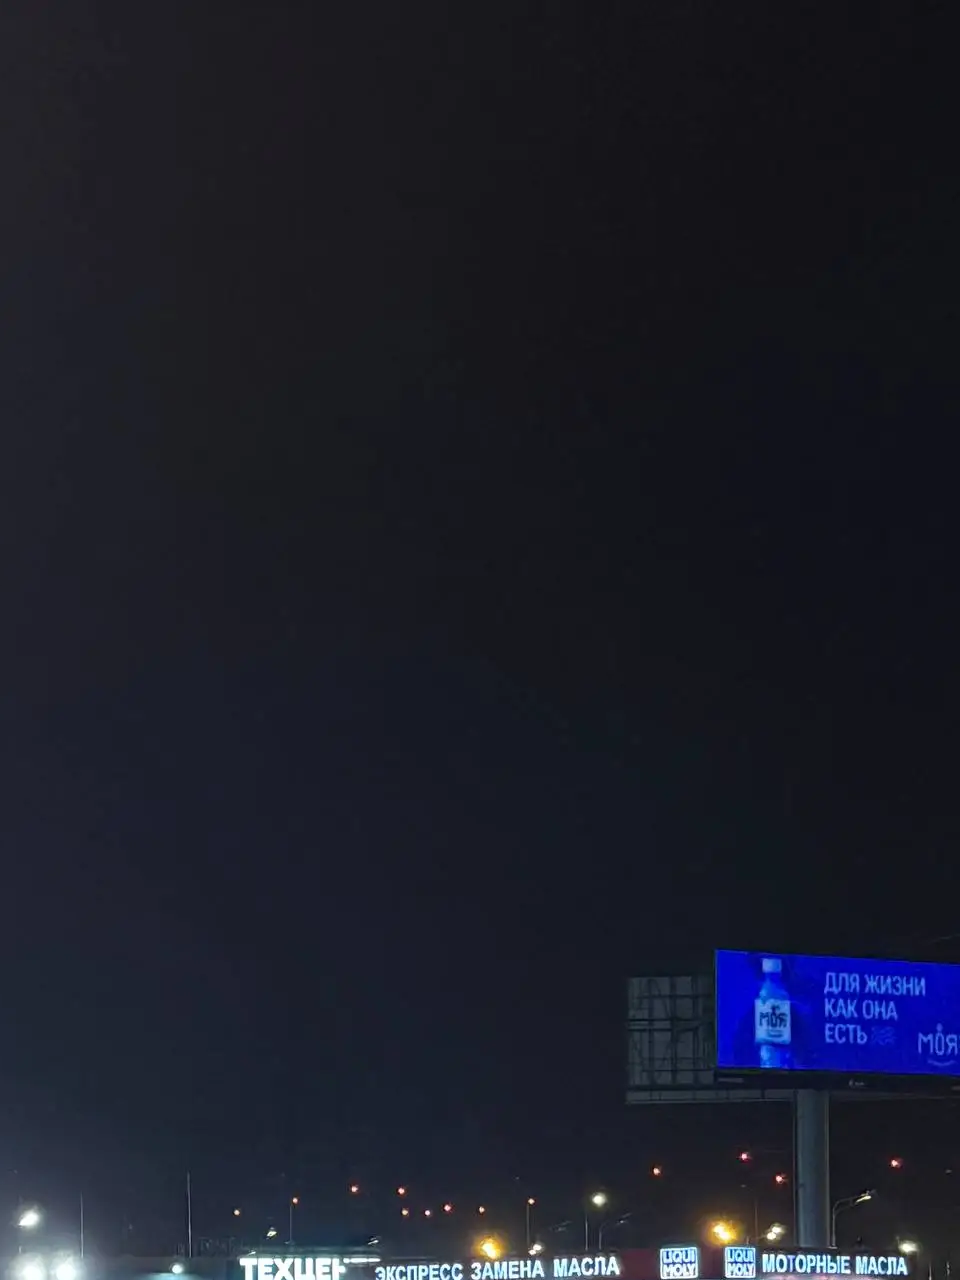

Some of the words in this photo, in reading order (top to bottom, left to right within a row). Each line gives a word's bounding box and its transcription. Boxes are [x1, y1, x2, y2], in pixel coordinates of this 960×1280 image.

[824, 972, 860, 994] ДЛЯ
[864, 974, 926, 996] ЖИЗНИ
[825, 998, 858, 1018] КАК
[862, 1000, 898, 1020] ОНА
[825, 1023, 868, 1044] ЕСТЬ
[470, 1260, 545, 1280] ЗАМЕНА
[553, 1256, 620, 1278] МАСЛА
[762, 1254, 851, 1274] МОТОРНЫЕ
[855, 1256, 908, 1276] МАСЛА
